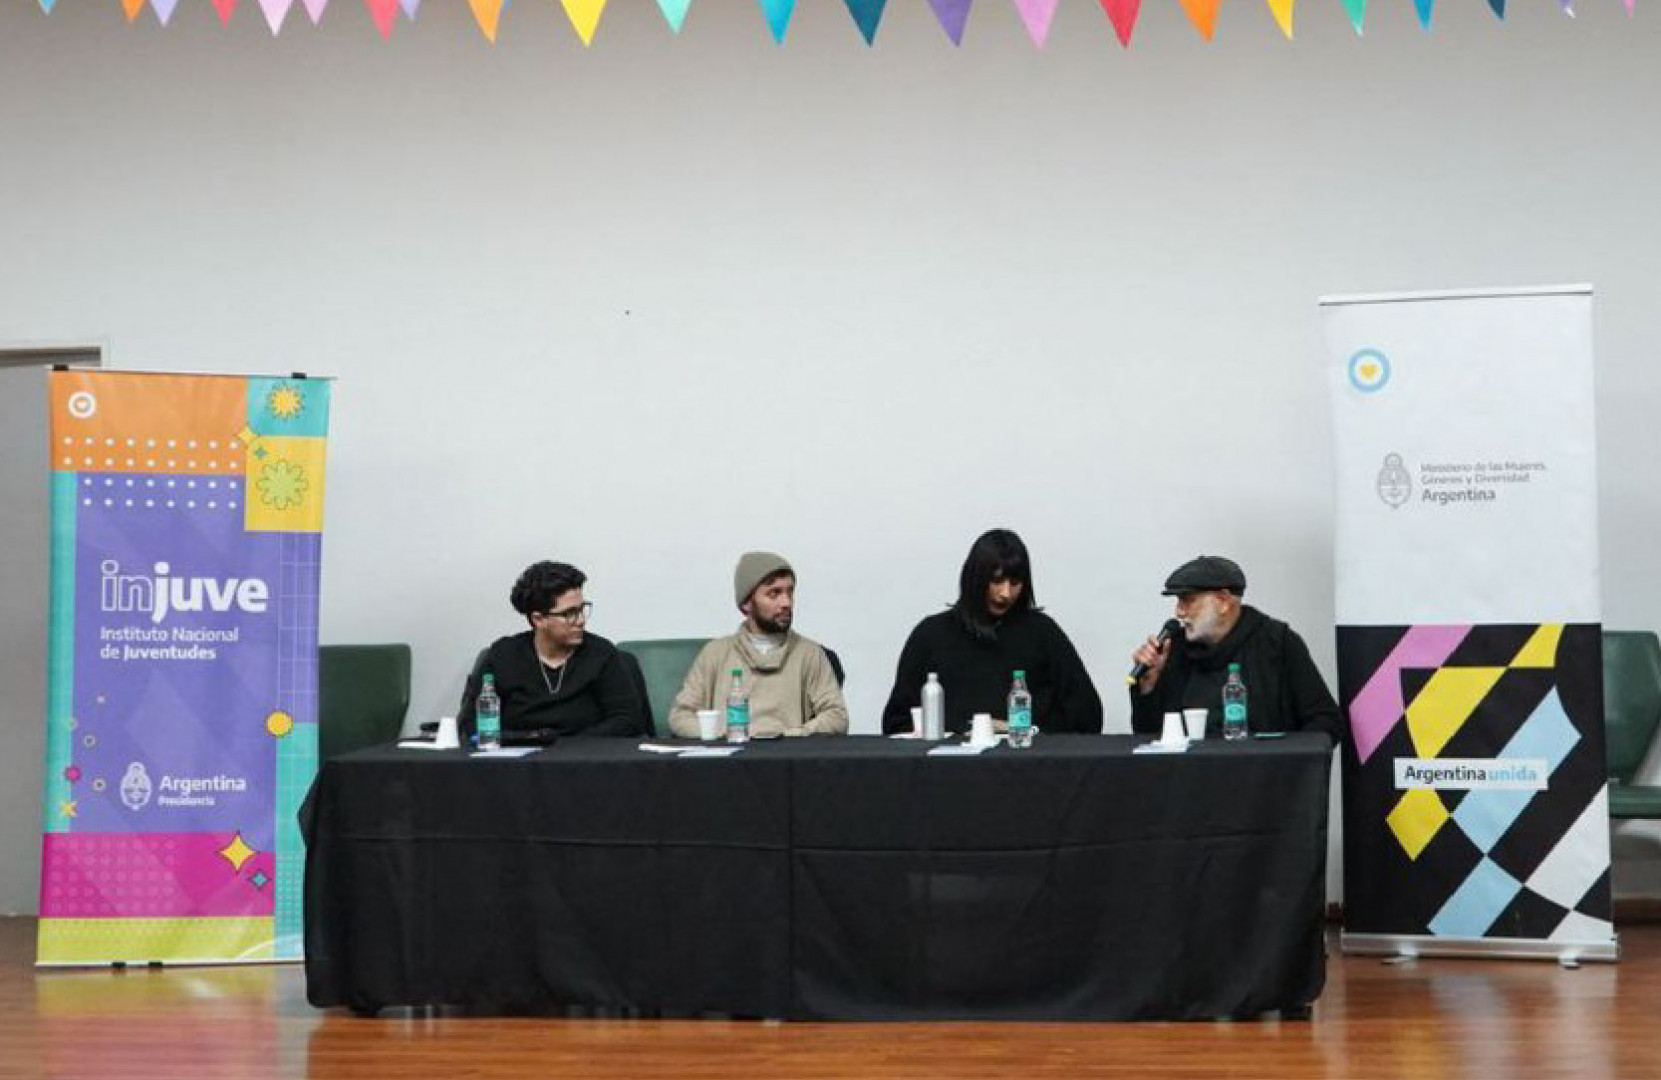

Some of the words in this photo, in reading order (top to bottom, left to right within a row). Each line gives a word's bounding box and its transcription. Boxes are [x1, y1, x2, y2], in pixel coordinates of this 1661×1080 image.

[1474, 462, 1487, 472] de
[1465, 475, 1472, 485] y
[1422, 489, 1496, 505] Argentina
[101, 560, 267, 623] injuve
[100, 627, 170, 643] Instituto
[172, 627, 238, 643] Nacional
[100, 645, 120, 660] de
[122, 645, 216, 661] Juventudes
[1405, 765, 1487, 784] Argentina
[1488, 765, 1537, 781] unida
[160, 776, 246, 796] Argentina
